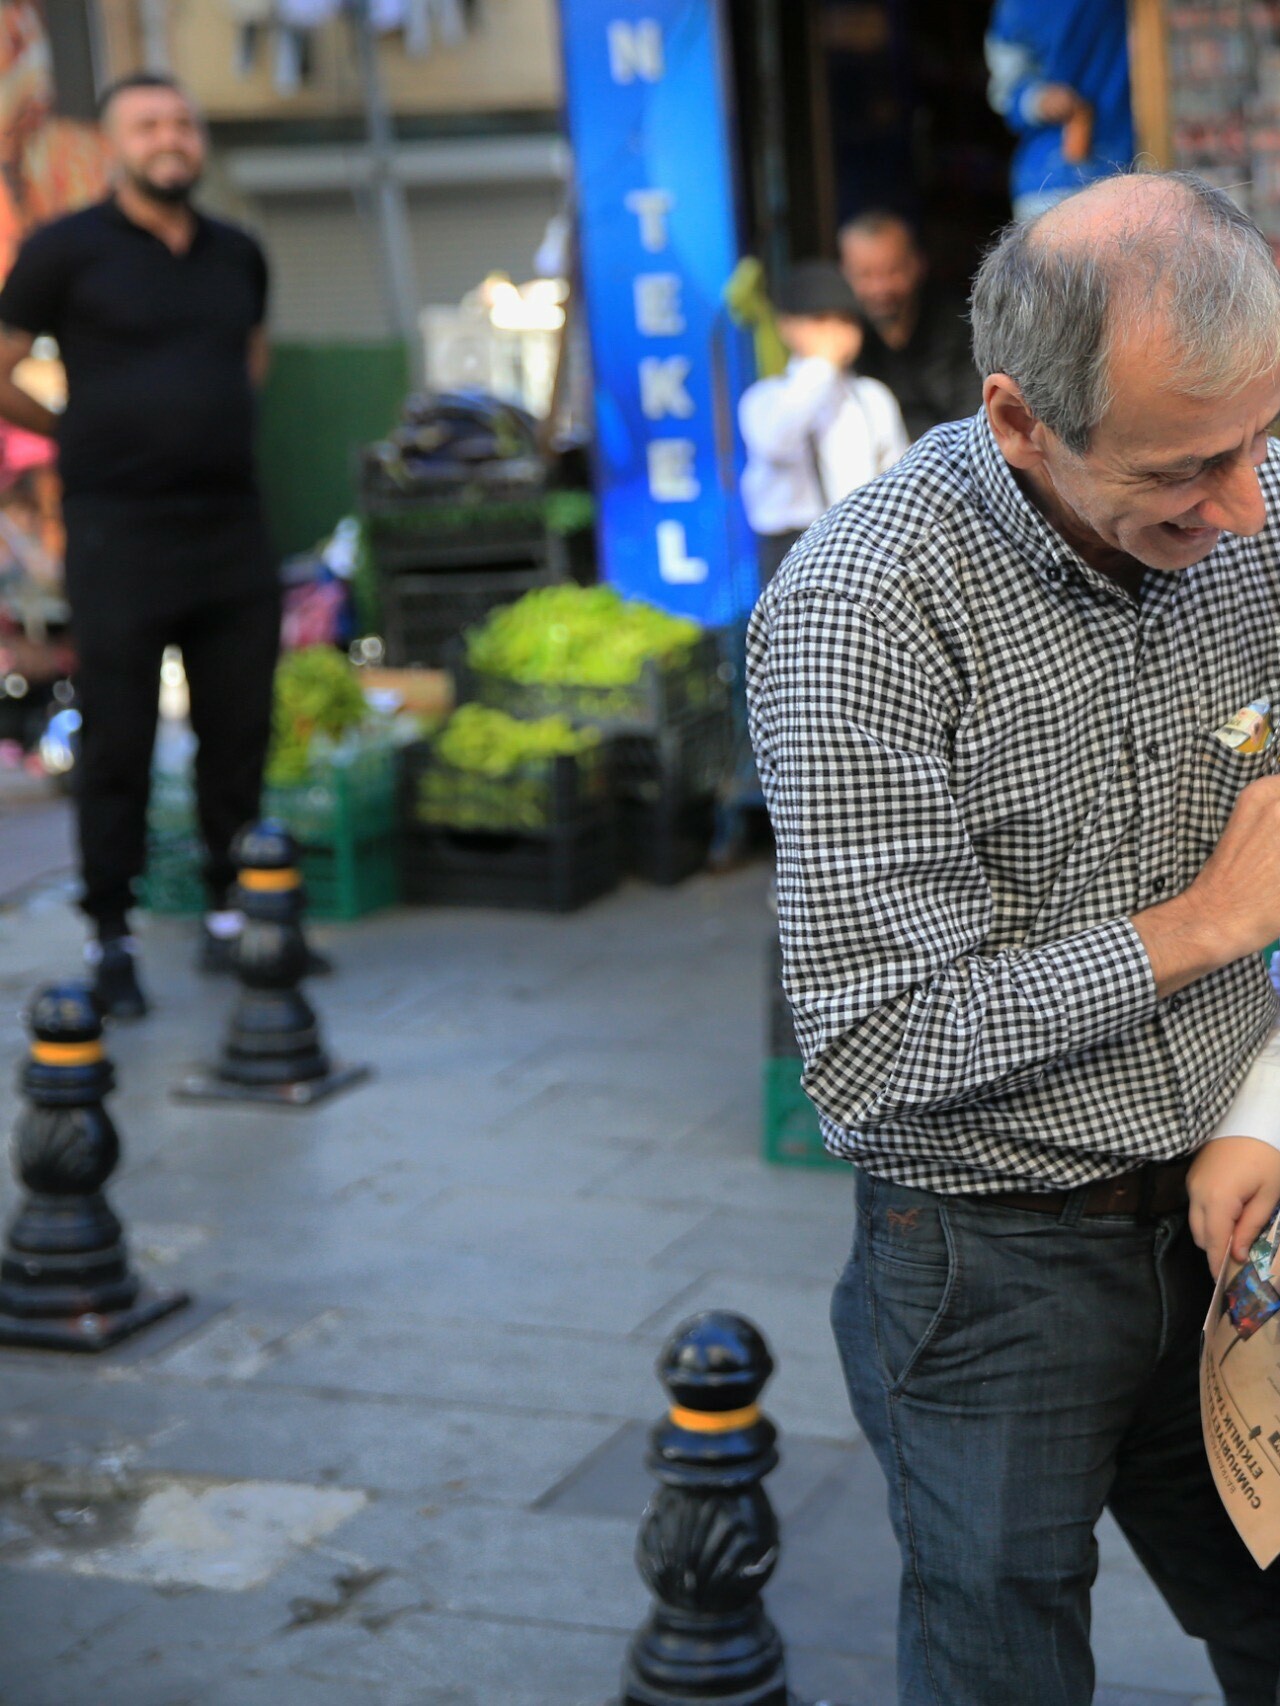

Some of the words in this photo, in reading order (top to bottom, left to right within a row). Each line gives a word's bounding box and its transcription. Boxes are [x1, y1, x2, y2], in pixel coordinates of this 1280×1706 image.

[627, 191, 708, 583] TEKEL
[1212, 1414, 1261, 1509] CUMHURİYET
[1223, 1413, 1264, 1480] ETKİNLİK
